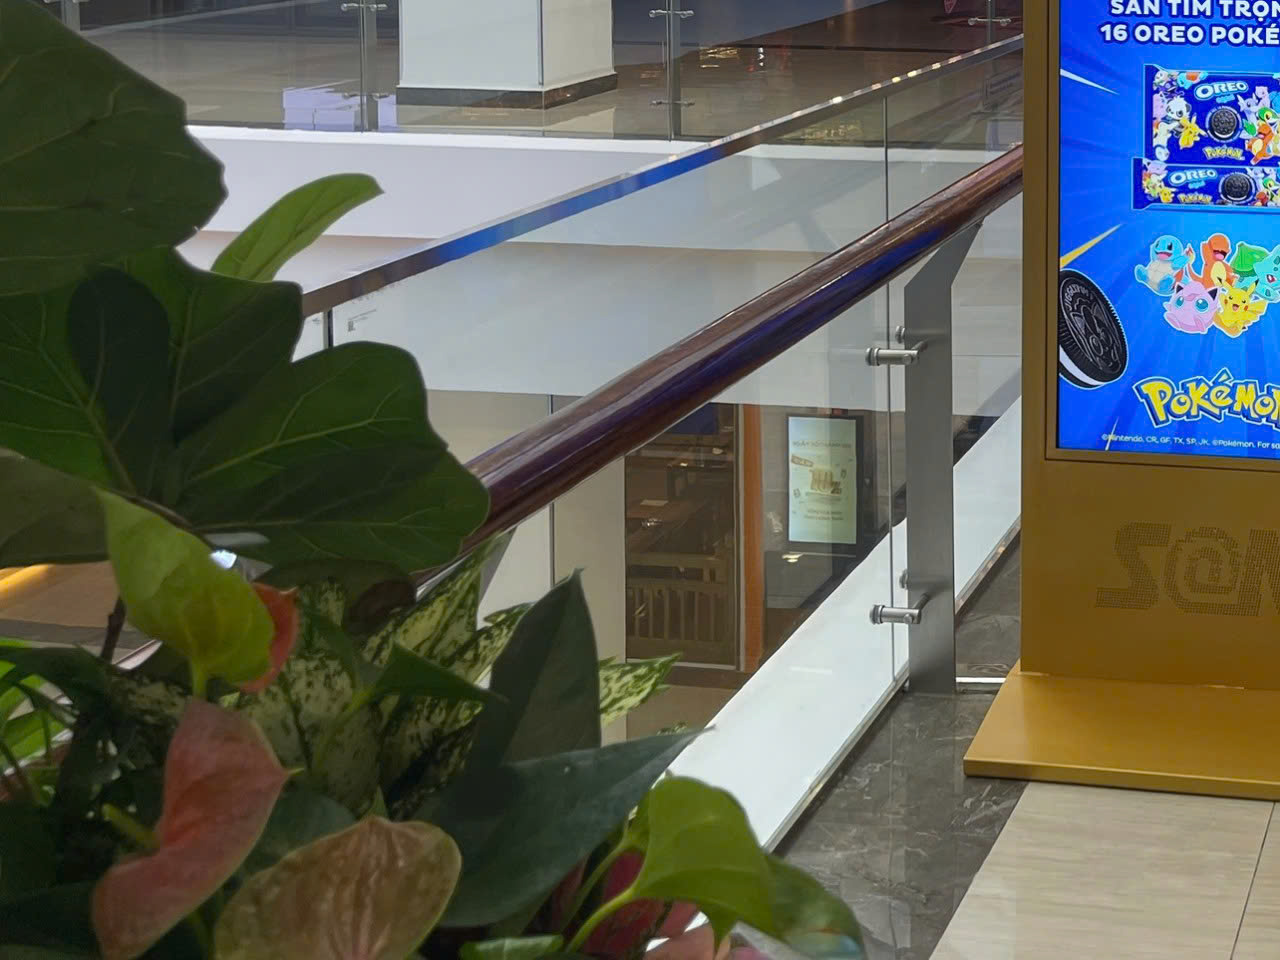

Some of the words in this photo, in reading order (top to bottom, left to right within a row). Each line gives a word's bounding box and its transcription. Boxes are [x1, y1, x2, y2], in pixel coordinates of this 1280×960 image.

[1100, 23, 1128, 42] 16
[1131, 24, 1205, 43] OREO
[1194, 81, 1249, 100] OREO
[1168, 169, 1217, 186] OREO
[1258, 441, 1270, 449] For
